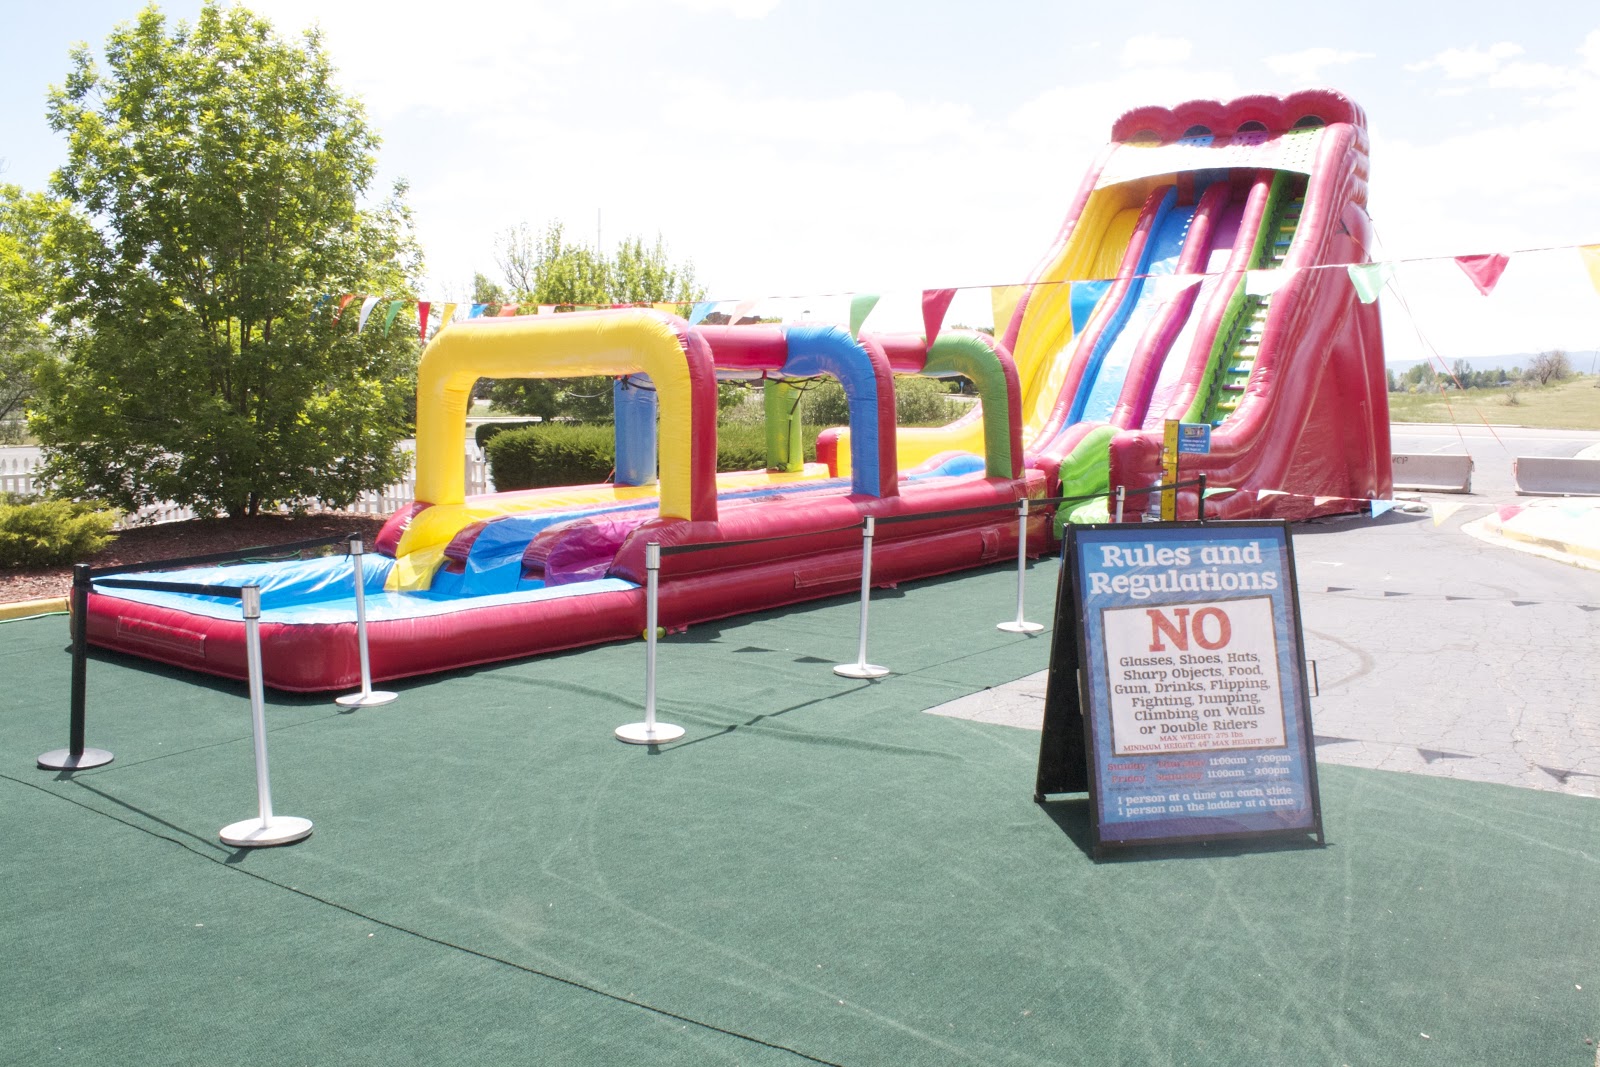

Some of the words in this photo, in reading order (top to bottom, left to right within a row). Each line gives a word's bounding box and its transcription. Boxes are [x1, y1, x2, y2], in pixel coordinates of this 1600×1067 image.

[1100, 544, 1191, 567] Rules
[1200, 542, 1262, 565] and
[1089, 567, 1278, 599] Regulations
[1146, 606, 1232, 652] NO
[1119, 655, 1176, 667] Glasses,
[1180, 654, 1223, 665] Shoes,
[1227, 652, 1260, 662] Hats,
[1123, 670, 1168, 682] Sharp
[1172, 667, 1224, 680] Objects,
[1228, 664, 1264, 676] Food,
[1114, 684, 1150, 695] Gum,
[1154, 680, 1206, 693] Drinks,
[1210, 678, 1270, 692] Flipping,
[1132, 696, 1194, 710] Fighting,
[1198, 692, 1261, 706] Jumping,
[1134, 709, 1199, 722] Climbing
[1204, 708, 1221, 718] on
[1226, 704, 1265, 716] Walls
[1140, 725, 1156, 735] or
[1160, 721, 1208, 734] Double
[1213, 718, 1258, 730] Riders
[1108, 763, 1146, 772] Sunday
[1209, 756, 1247, 766] 11:00am
[1256, 754, 1292, 764] 7:00pm
[1112, 775, 1146, 784] Friday
[1207, 769, 1245, 778] 11:00am
[1254, 767, 1290, 776] 9:00pm
[1126, 794, 1165, 806] person
[1168, 793, 1180, 802] at
[1182, 794, 1190, 802] a
[1194, 790, 1216, 800] time
[1220, 790, 1234, 798] on
[1236, 787, 1264, 798] each
[1266, 786, 1292, 796] slide
[1126, 806, 1166, 817] person
[1168, 804, 1184, 813] on
[1186, 802, 1204, 812] the
[1207, 800, 1242, 810] ladder
[1245, 799, 1256, 808] at
[1258, 800, 1266, 808] a
[1270, 796, 1294, 806] time
